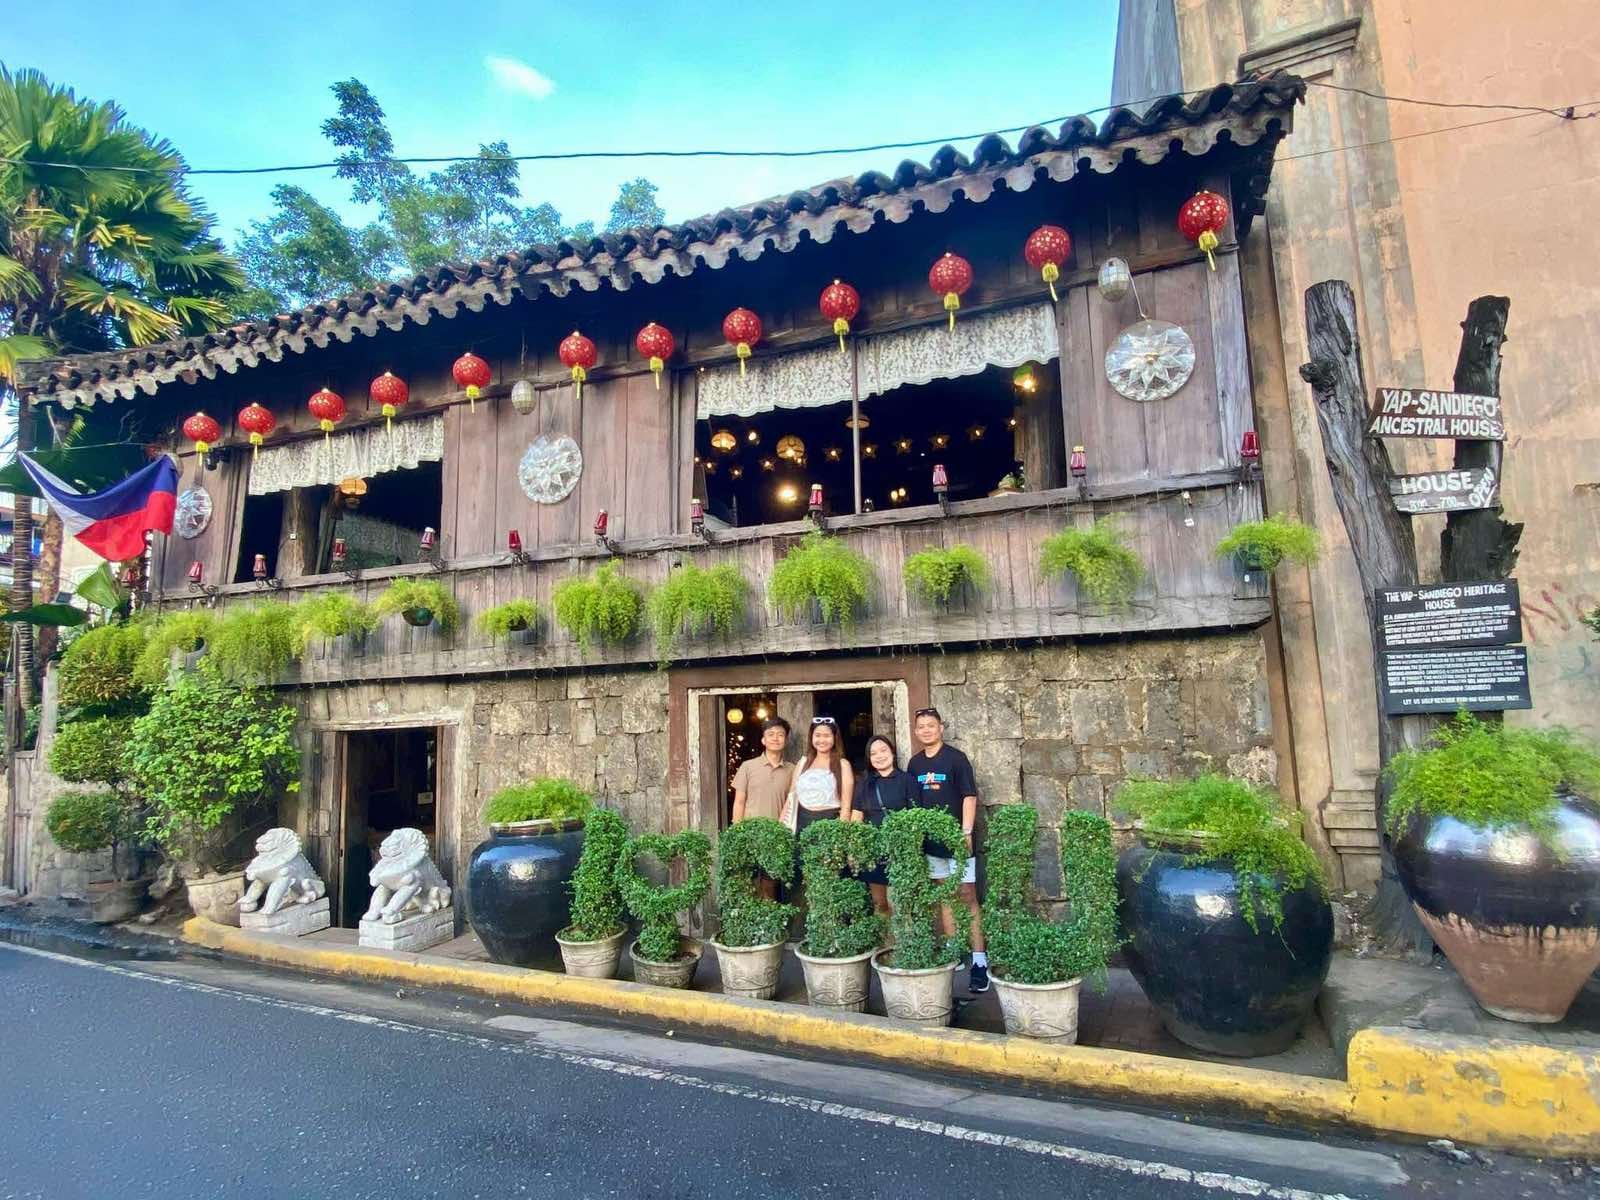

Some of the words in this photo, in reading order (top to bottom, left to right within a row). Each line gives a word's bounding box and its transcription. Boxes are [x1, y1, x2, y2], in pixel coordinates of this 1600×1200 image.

[1382, 389, 1499, 417] YAP-SANDIEGO
[1369, 416, 1448, 435] ANCESTRAL
[1451, 419, 1503, 439] HOUSE
[1401, 472, 1474, 494] HOUSE
[1469, 467, 1495, 507] OPEN
[1385, 592, 1400, 603] THE
[1463, 584, 1507, 597] HERITAGE
[1425, 599, 1456, 611] HOUSE
